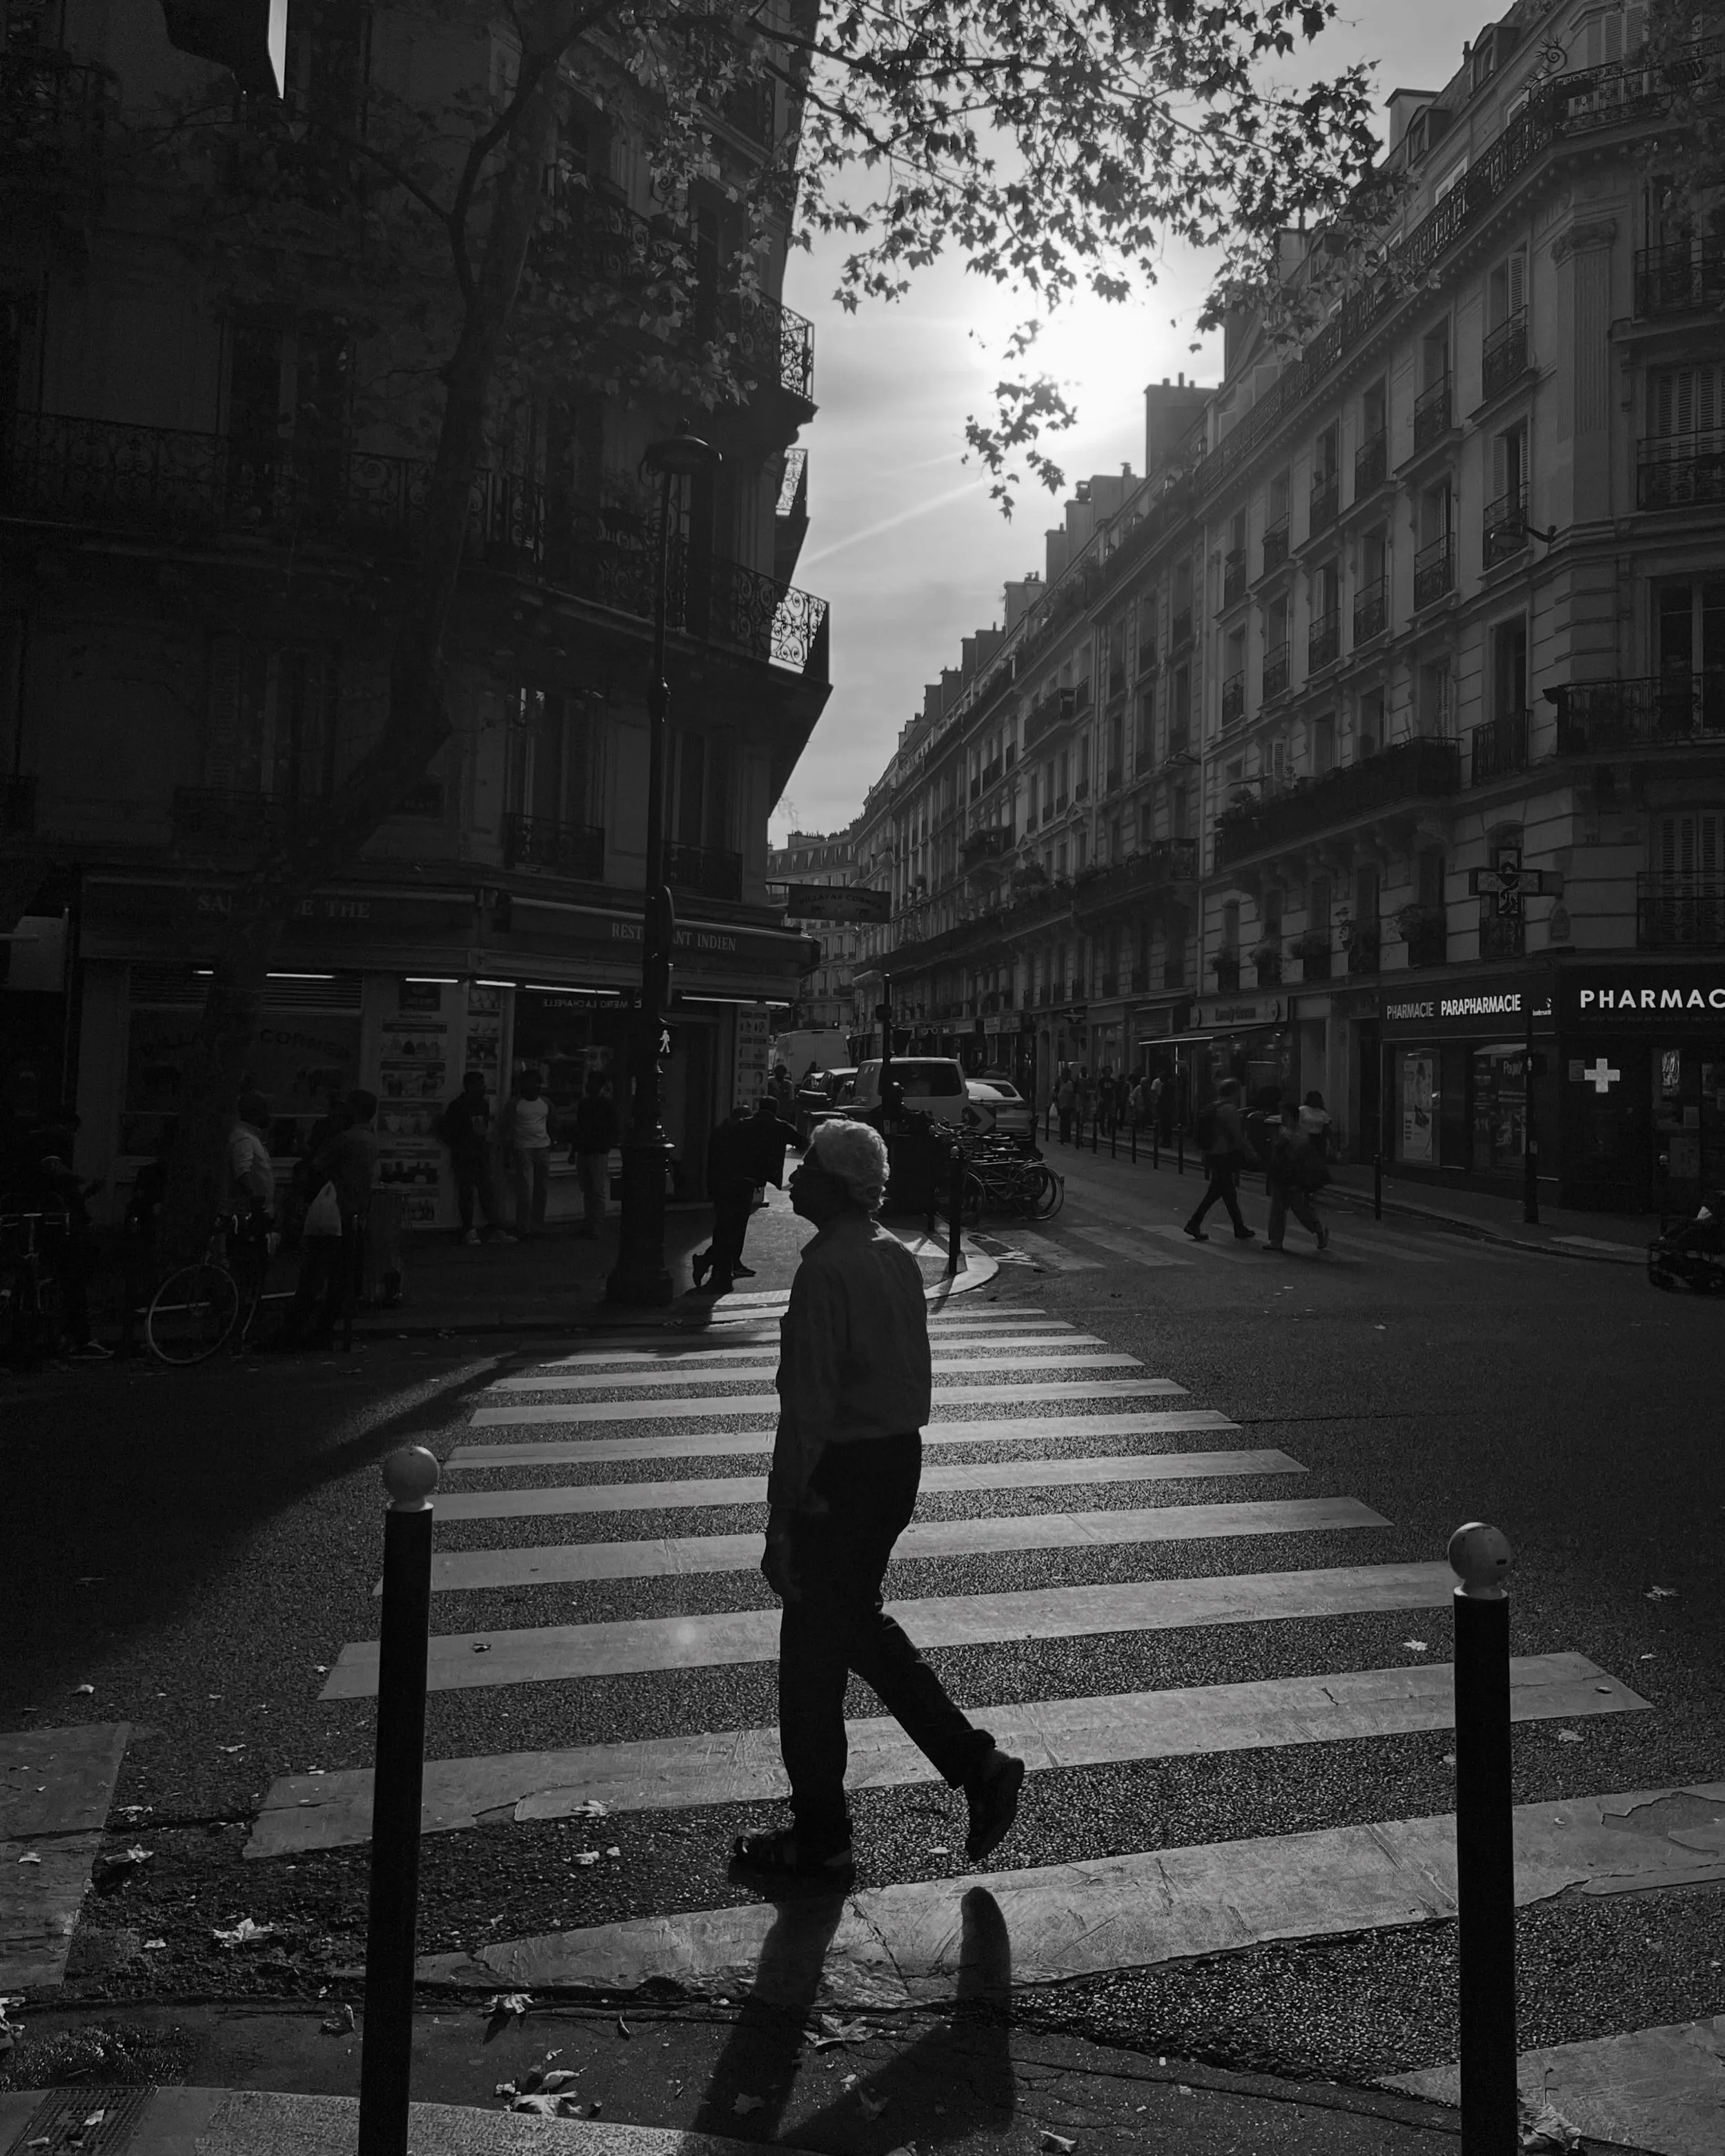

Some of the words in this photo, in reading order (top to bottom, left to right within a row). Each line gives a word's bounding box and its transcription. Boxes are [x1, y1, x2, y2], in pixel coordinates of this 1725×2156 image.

[326, 900, 371, 918] THE
[698, 933, 736, 951] INDIEN
[1386, 1001, 1436, 1020] PHARMACIE
[1441, 993, 1521, 1016] PARAPHARMACIE
[1580, 989, 1725, 1009] PHARMAC
